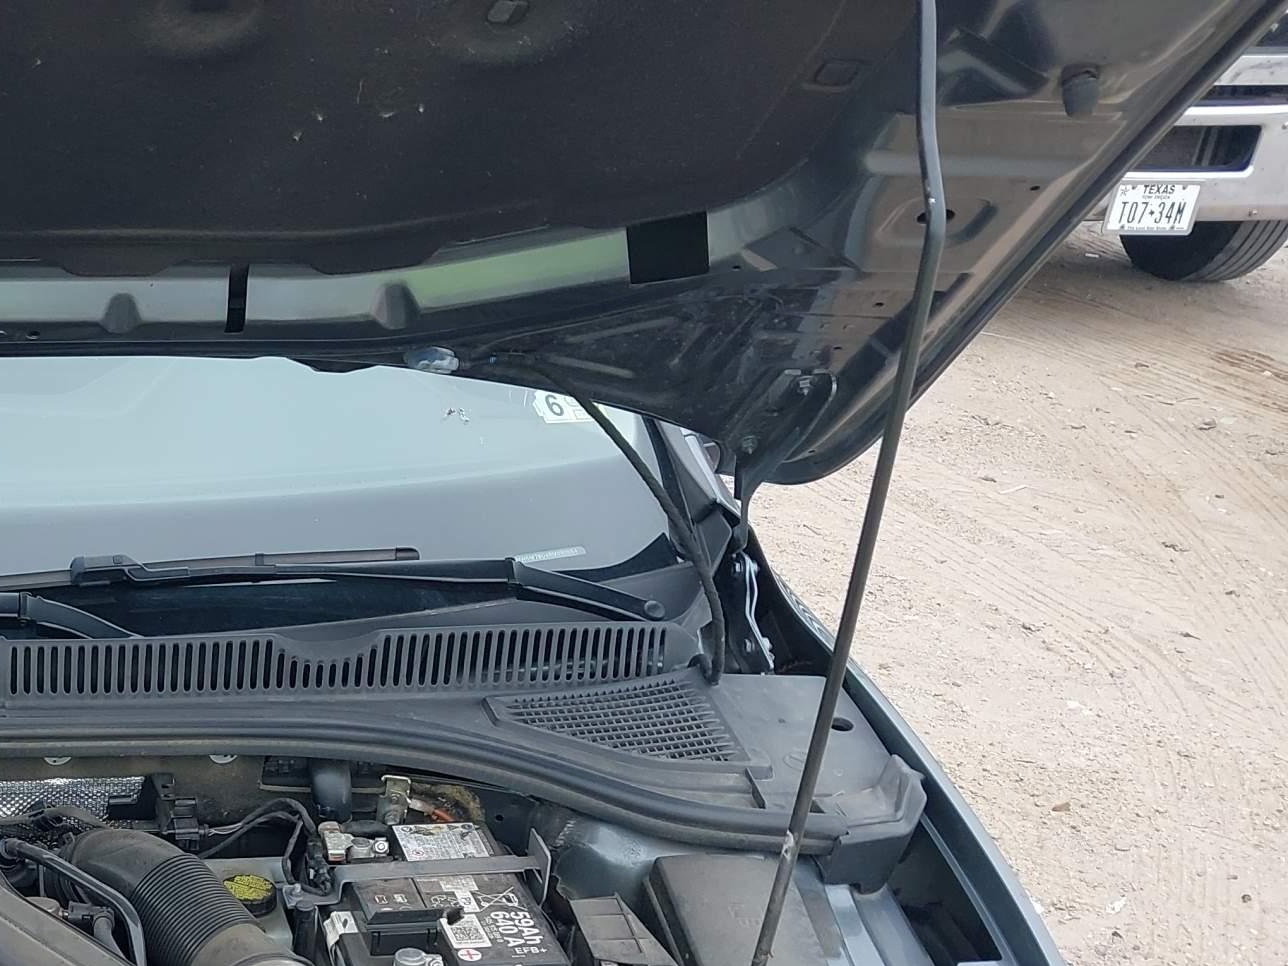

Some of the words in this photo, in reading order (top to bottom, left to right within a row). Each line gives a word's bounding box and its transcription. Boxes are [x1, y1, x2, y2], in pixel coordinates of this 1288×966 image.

[1143, 184, 1175, 194] TEXAS
[544, 394, 564, 417] 6
[490, 911, 519, 934] 640
[510, 911, 544, 945] 59Ah
